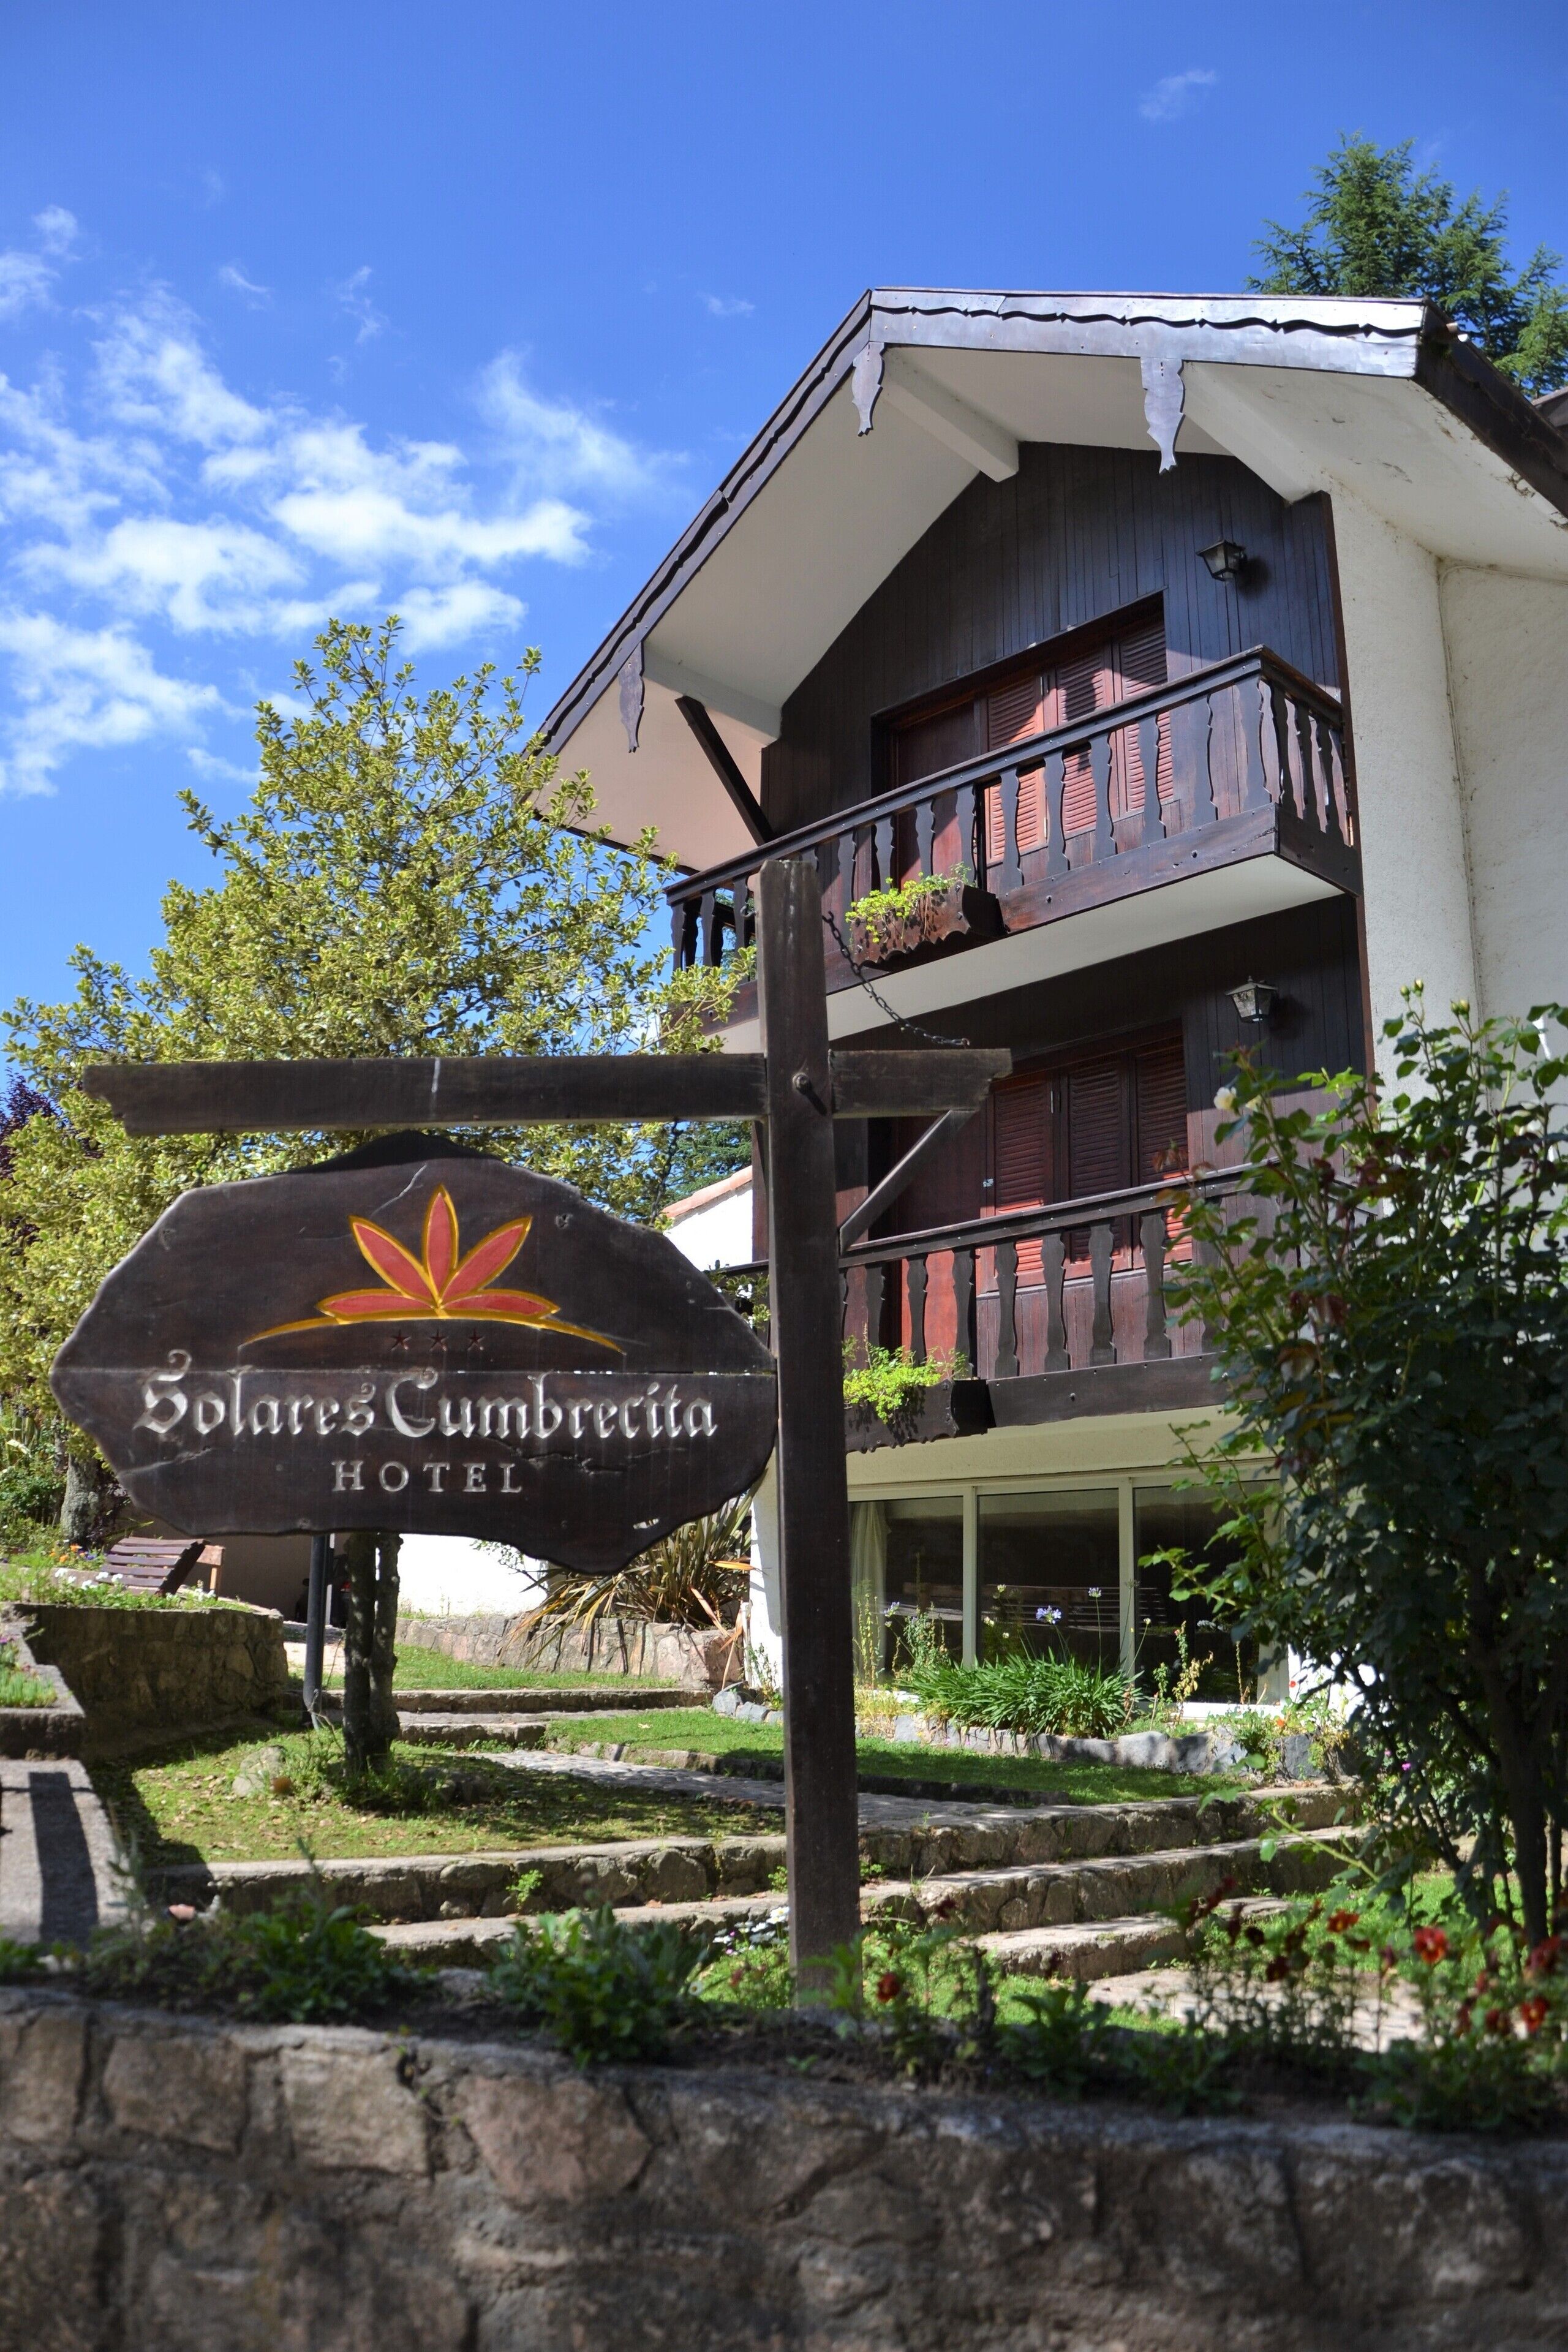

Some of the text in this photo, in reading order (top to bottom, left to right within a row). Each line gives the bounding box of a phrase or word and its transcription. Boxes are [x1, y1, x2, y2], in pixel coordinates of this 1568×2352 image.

[133, 1349, 718, 1438] Solares Cumbrecita
[331, 1460, 522, 1493] HOTEL
